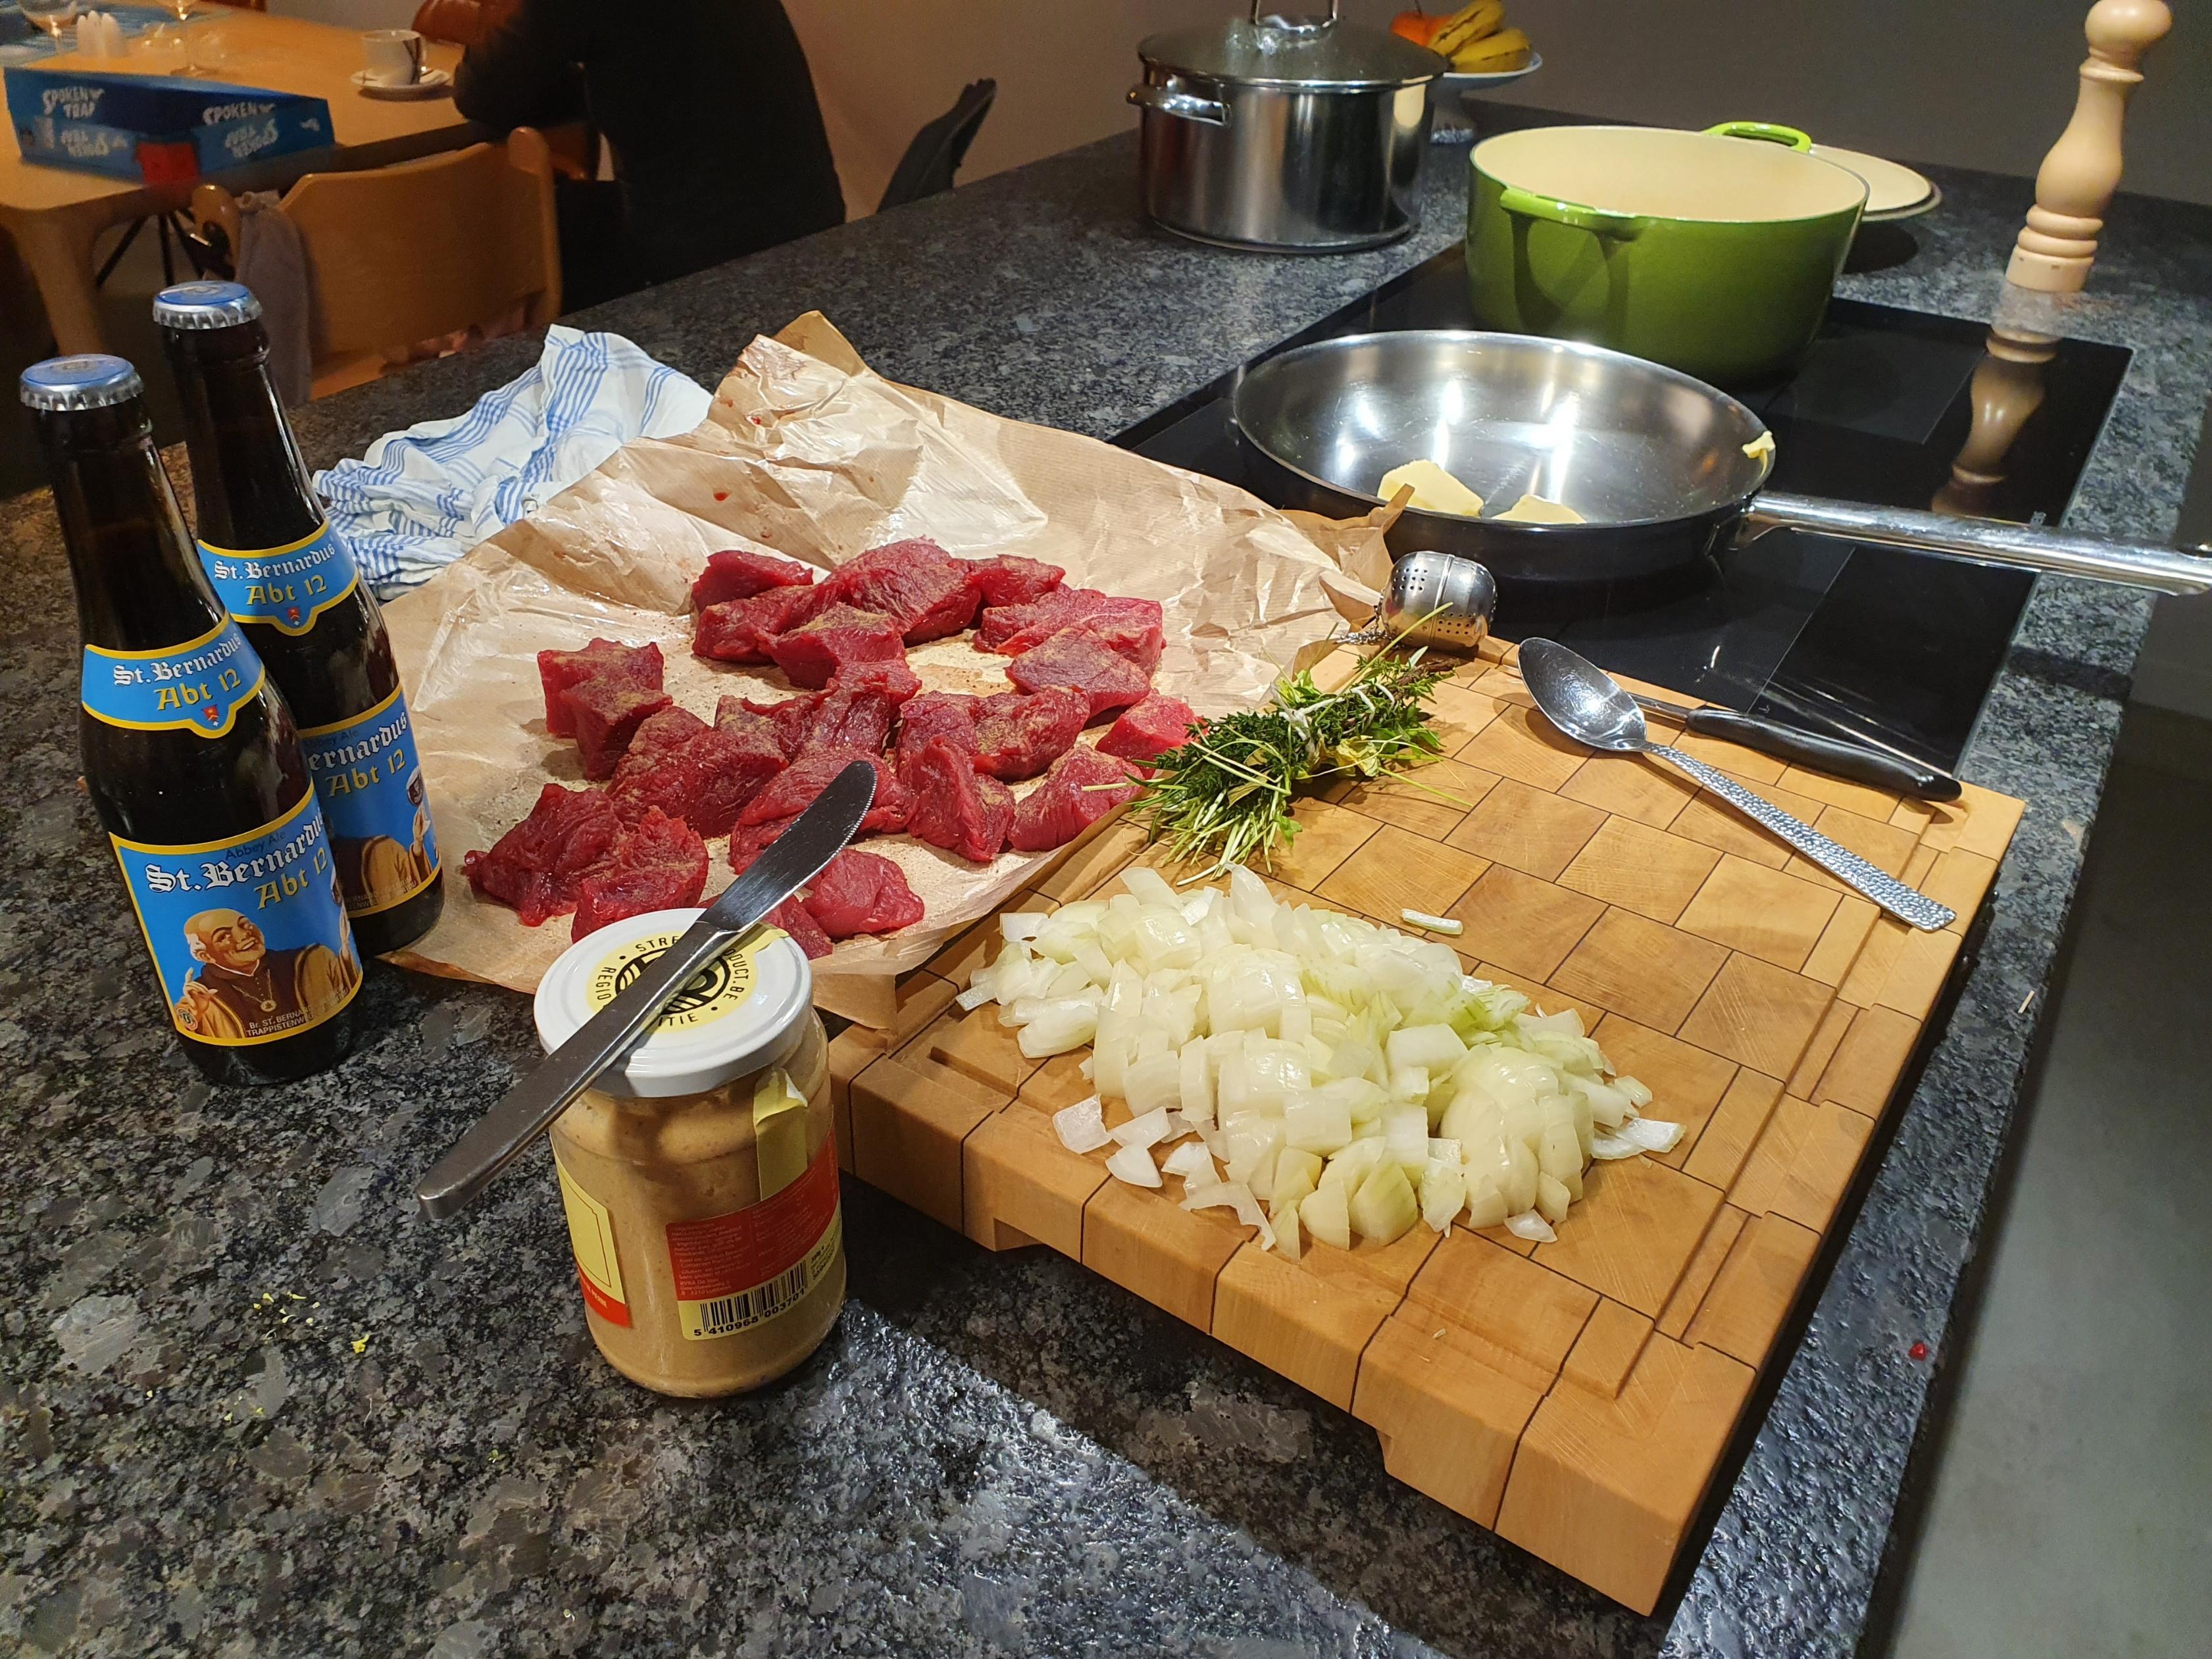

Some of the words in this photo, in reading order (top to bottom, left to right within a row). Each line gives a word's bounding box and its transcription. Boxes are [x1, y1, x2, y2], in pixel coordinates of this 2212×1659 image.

[245, 582, 297, 606] Abt
[303, 574, 327, 596] 12
[154, 682, 213, 710] Abt
[218, 668, 241, 691] 12
[308, 712, 407, 771] ernardus
[325, 766, 380, 797] Abt
[387, 749, 406, 774] 12
[225, 842, 264, 860] Abbey
[268, 831, 287, 847] Ale
[253, 868, 309, 910] Abt
[313, 847, 328, 876] 12
[595, 966, 616, 1001] REGIO
[708, 1316, 759, 1335] 410968
[764, 1288, 805, 1318] 003701
